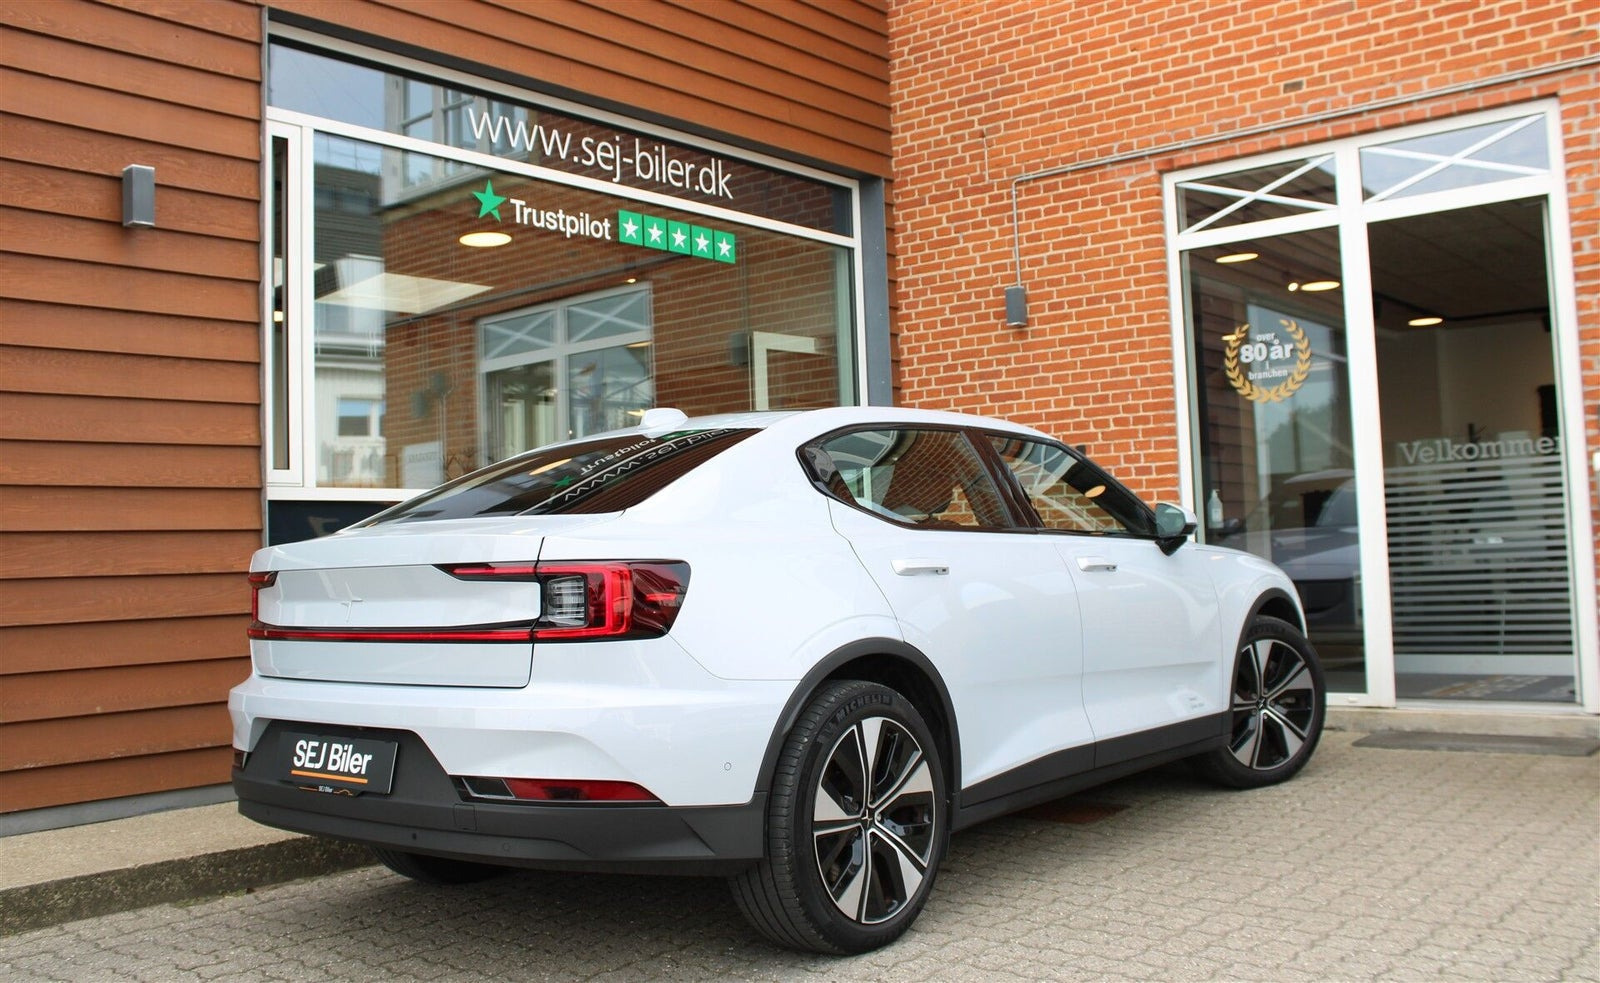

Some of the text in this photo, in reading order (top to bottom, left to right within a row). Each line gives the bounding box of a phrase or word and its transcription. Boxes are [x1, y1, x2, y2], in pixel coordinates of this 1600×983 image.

[468, 108, 733, 199] www.sej-biler.dk
[510, 198, 611, 240] Trustpilot
[1240, 339, 1293, 363] 80 år
[1256, 332, 1275, 342] over
[1248, 369, 1288, 380] branchen
[835, 694, 891, 722] MICHELIN
[293, 740, 372, 774] SEJ Biler
